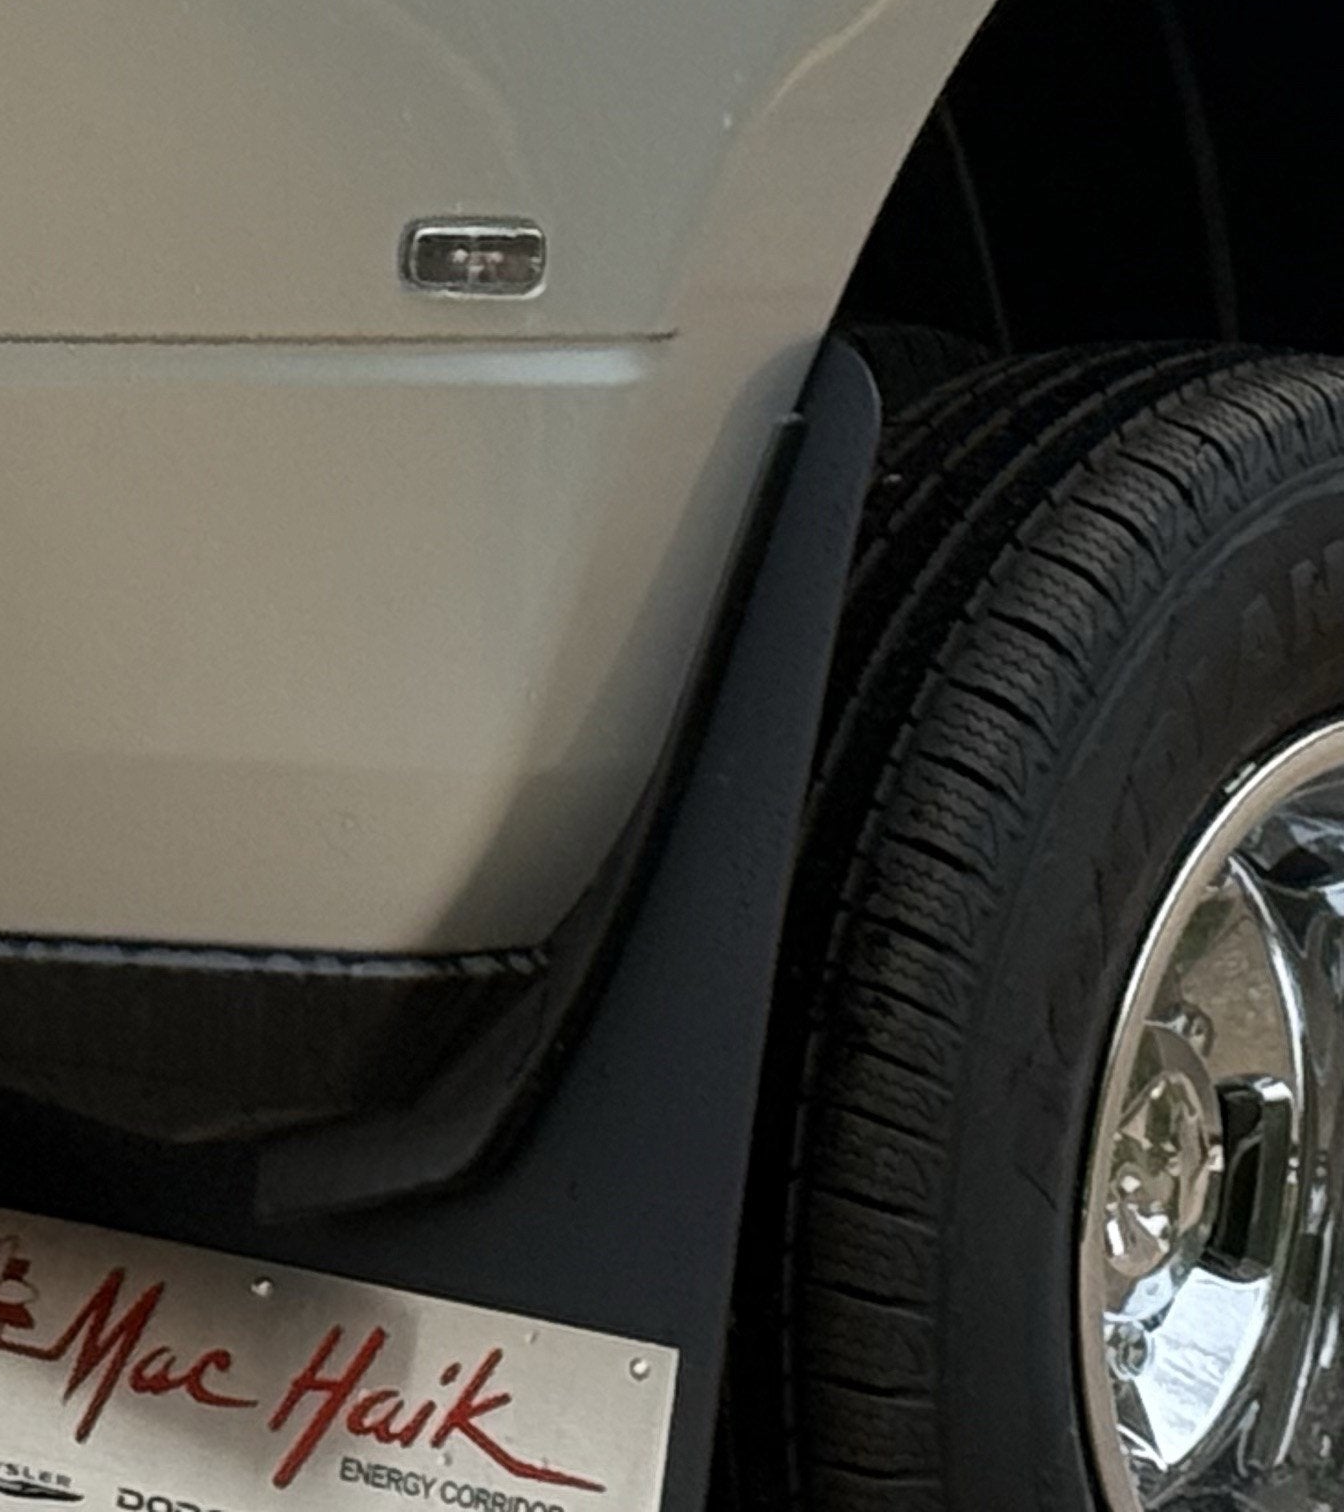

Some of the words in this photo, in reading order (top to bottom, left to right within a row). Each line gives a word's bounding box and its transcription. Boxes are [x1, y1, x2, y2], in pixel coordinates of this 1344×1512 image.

[46, 1267, 258, 1443] Mac
[268, 1324, 607, 1489] Haik
[339, 1456, 437, 1499] ENERGY
[440, 1480, 566, 1512] CORRIDO
